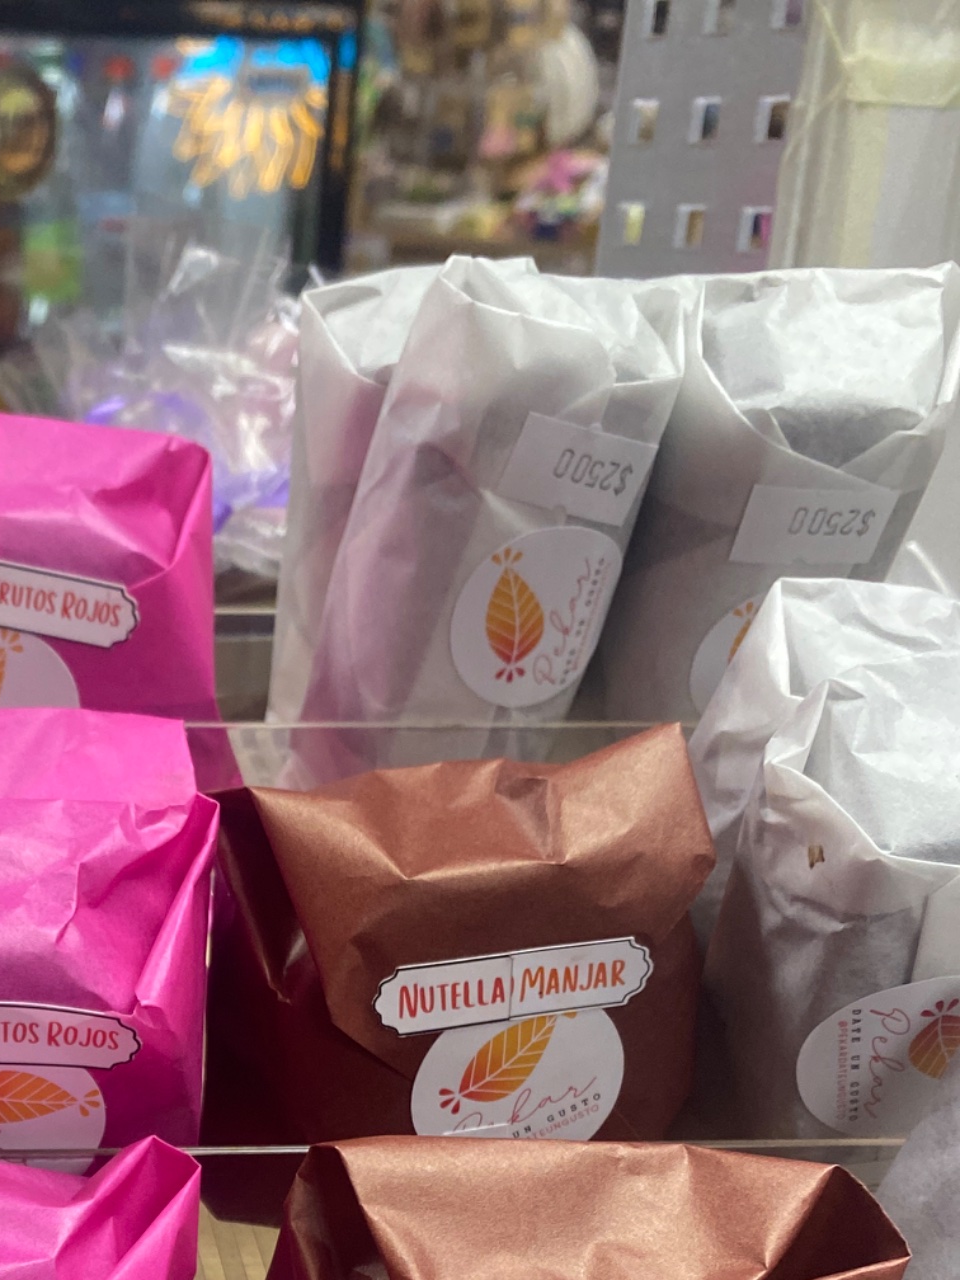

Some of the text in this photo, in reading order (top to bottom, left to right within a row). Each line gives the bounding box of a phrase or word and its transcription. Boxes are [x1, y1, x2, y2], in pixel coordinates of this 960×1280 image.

[553, 448, 633, 496] $2500
[787, 506, 876, 537] $2500
[60, 591, 123, 627] ROJOS
[398, 959, 627, 1019] NUTELLA MANJAR
[46, 1022, 120, 1050] ROJOS
[546, 1092, 602, 1122] GUSTO
